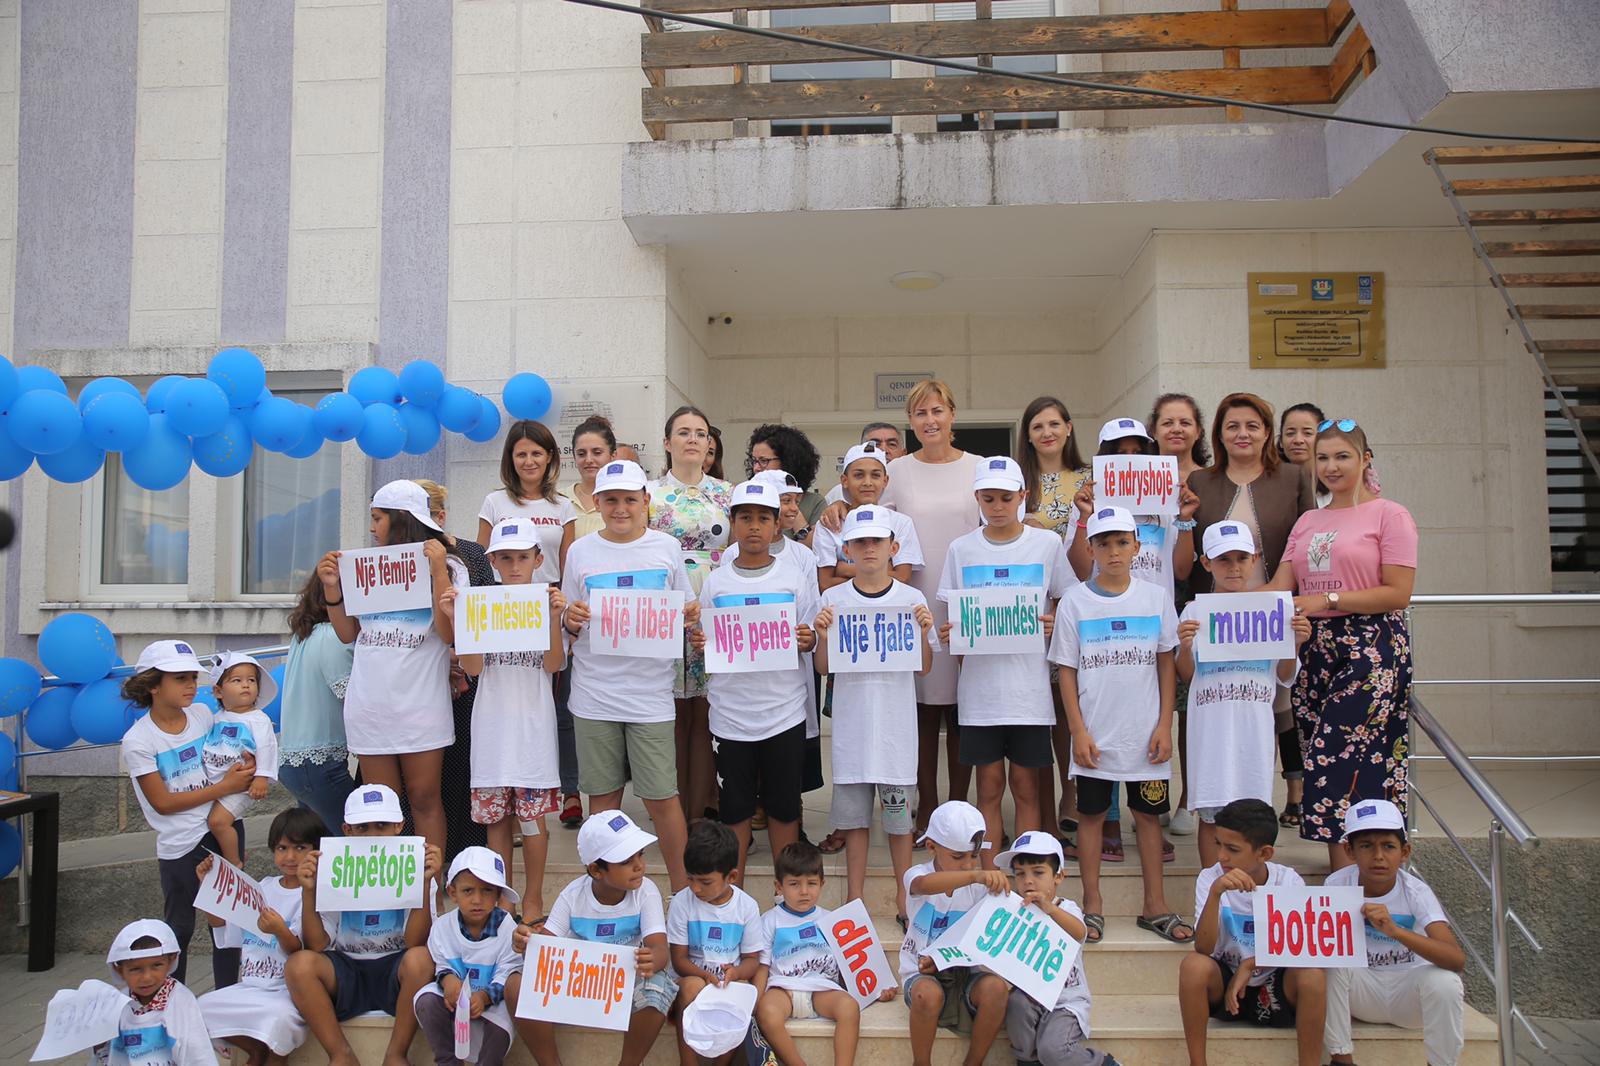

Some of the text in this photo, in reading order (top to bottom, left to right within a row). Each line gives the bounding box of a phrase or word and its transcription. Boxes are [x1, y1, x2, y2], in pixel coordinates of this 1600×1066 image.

[889, 381, 918, 390] QENDR
[1104, 461, 1173, 505] të ndryshojë
[355, 552, 416, 596] Një fëmijë
[1302, 579, 1342, 591] LIMITED
[467, 592, 542, 641] Një mësues
[601, 596, 677, 649] Një libër
[713, 610, 791, 663] Një penë
[839, 613, 914, 663] Një fjalë
[960, 593, 1039, 648] Një mundësi
[1209, 598, 1284, 644] mund
[882, 787, 904, 795] adidas
[232, 873, 266, 912] perso
[331, 844, 416, 898] shpëtojë
[976, 906, 1067, 982] gjithë
[1267, 894, 1353, 957] botën
[534, 945, 625, 1014] Një familje
[832, 919, 877, 997] dhe
